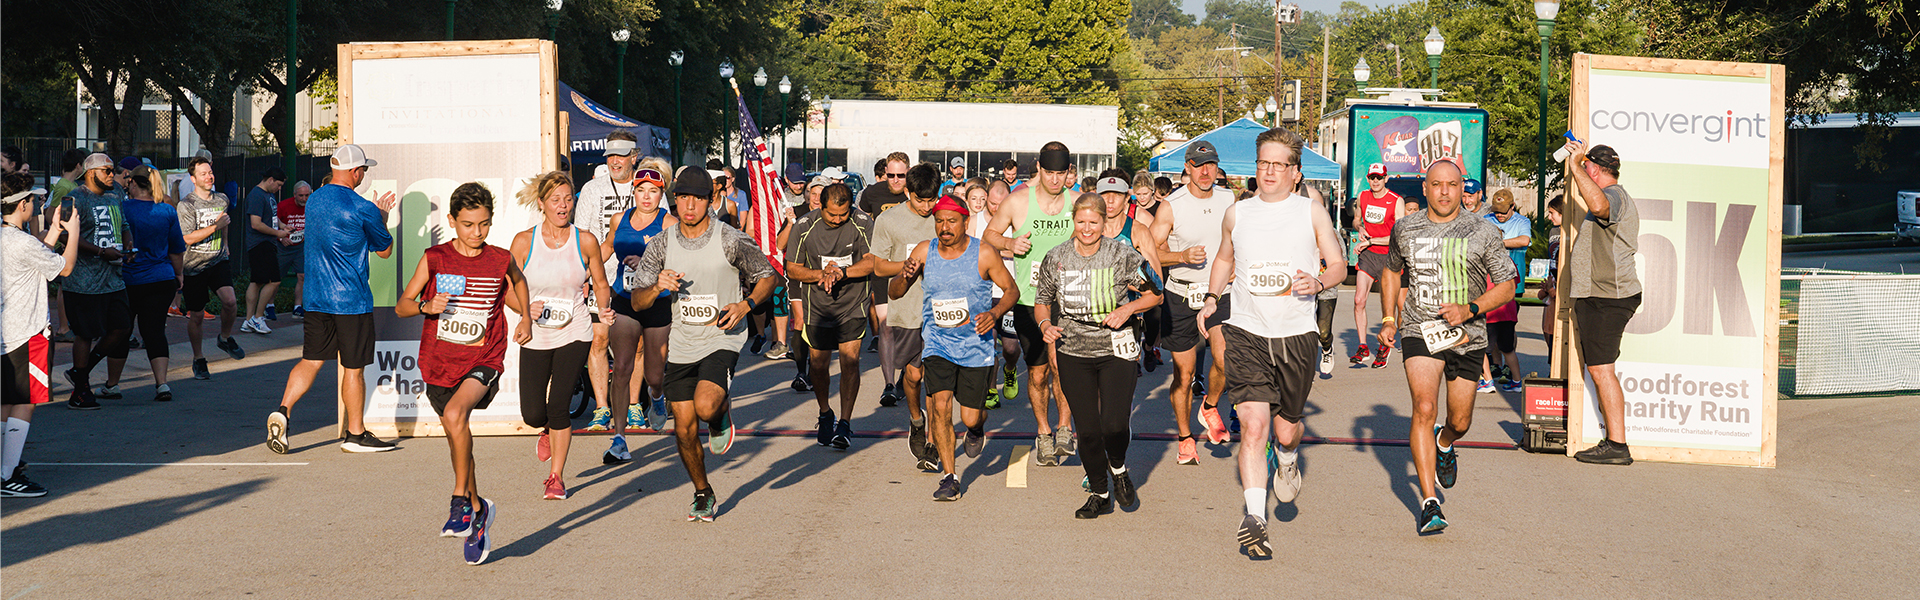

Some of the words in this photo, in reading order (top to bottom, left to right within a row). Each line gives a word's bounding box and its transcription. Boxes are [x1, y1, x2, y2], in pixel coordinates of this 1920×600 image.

[381, 107, 519, 120] INVITATIONAL
[1591, 109, 1766, 144] convergint
[1382, 131, 1400, 150] K
[1397, 132, 1413, 142] STAR
[1420, 129, 1459, 170] 99.7
[1383, 151, 1417, 166] Country
[95, 205, 115, 249] RUN
[1033, 219, 1070, 229] STRAIT
[1034, 228, 1067, 237] SPEED
[1414, 237, 1443, 305] RUN
[1624, 198, 1757, 338] 5K
[1250, 274, 1285, 288] 3966
[539, 308, 566, 322] 066
[681, 305, 712, 318] 3069
[935, 309, 963, 321] 3969
[441, 318, 479, 337] 3060
[1426, 327, 1459, 345] 3125
[1617, 372, 1749, 399] oodforest
[1625, 397, 1692, 426] arity
[1700, 400, 1750, 424] Run
[1643, 425, 1680, 434] Woodforest
[1681, 427, 1713, 436] Charitable
